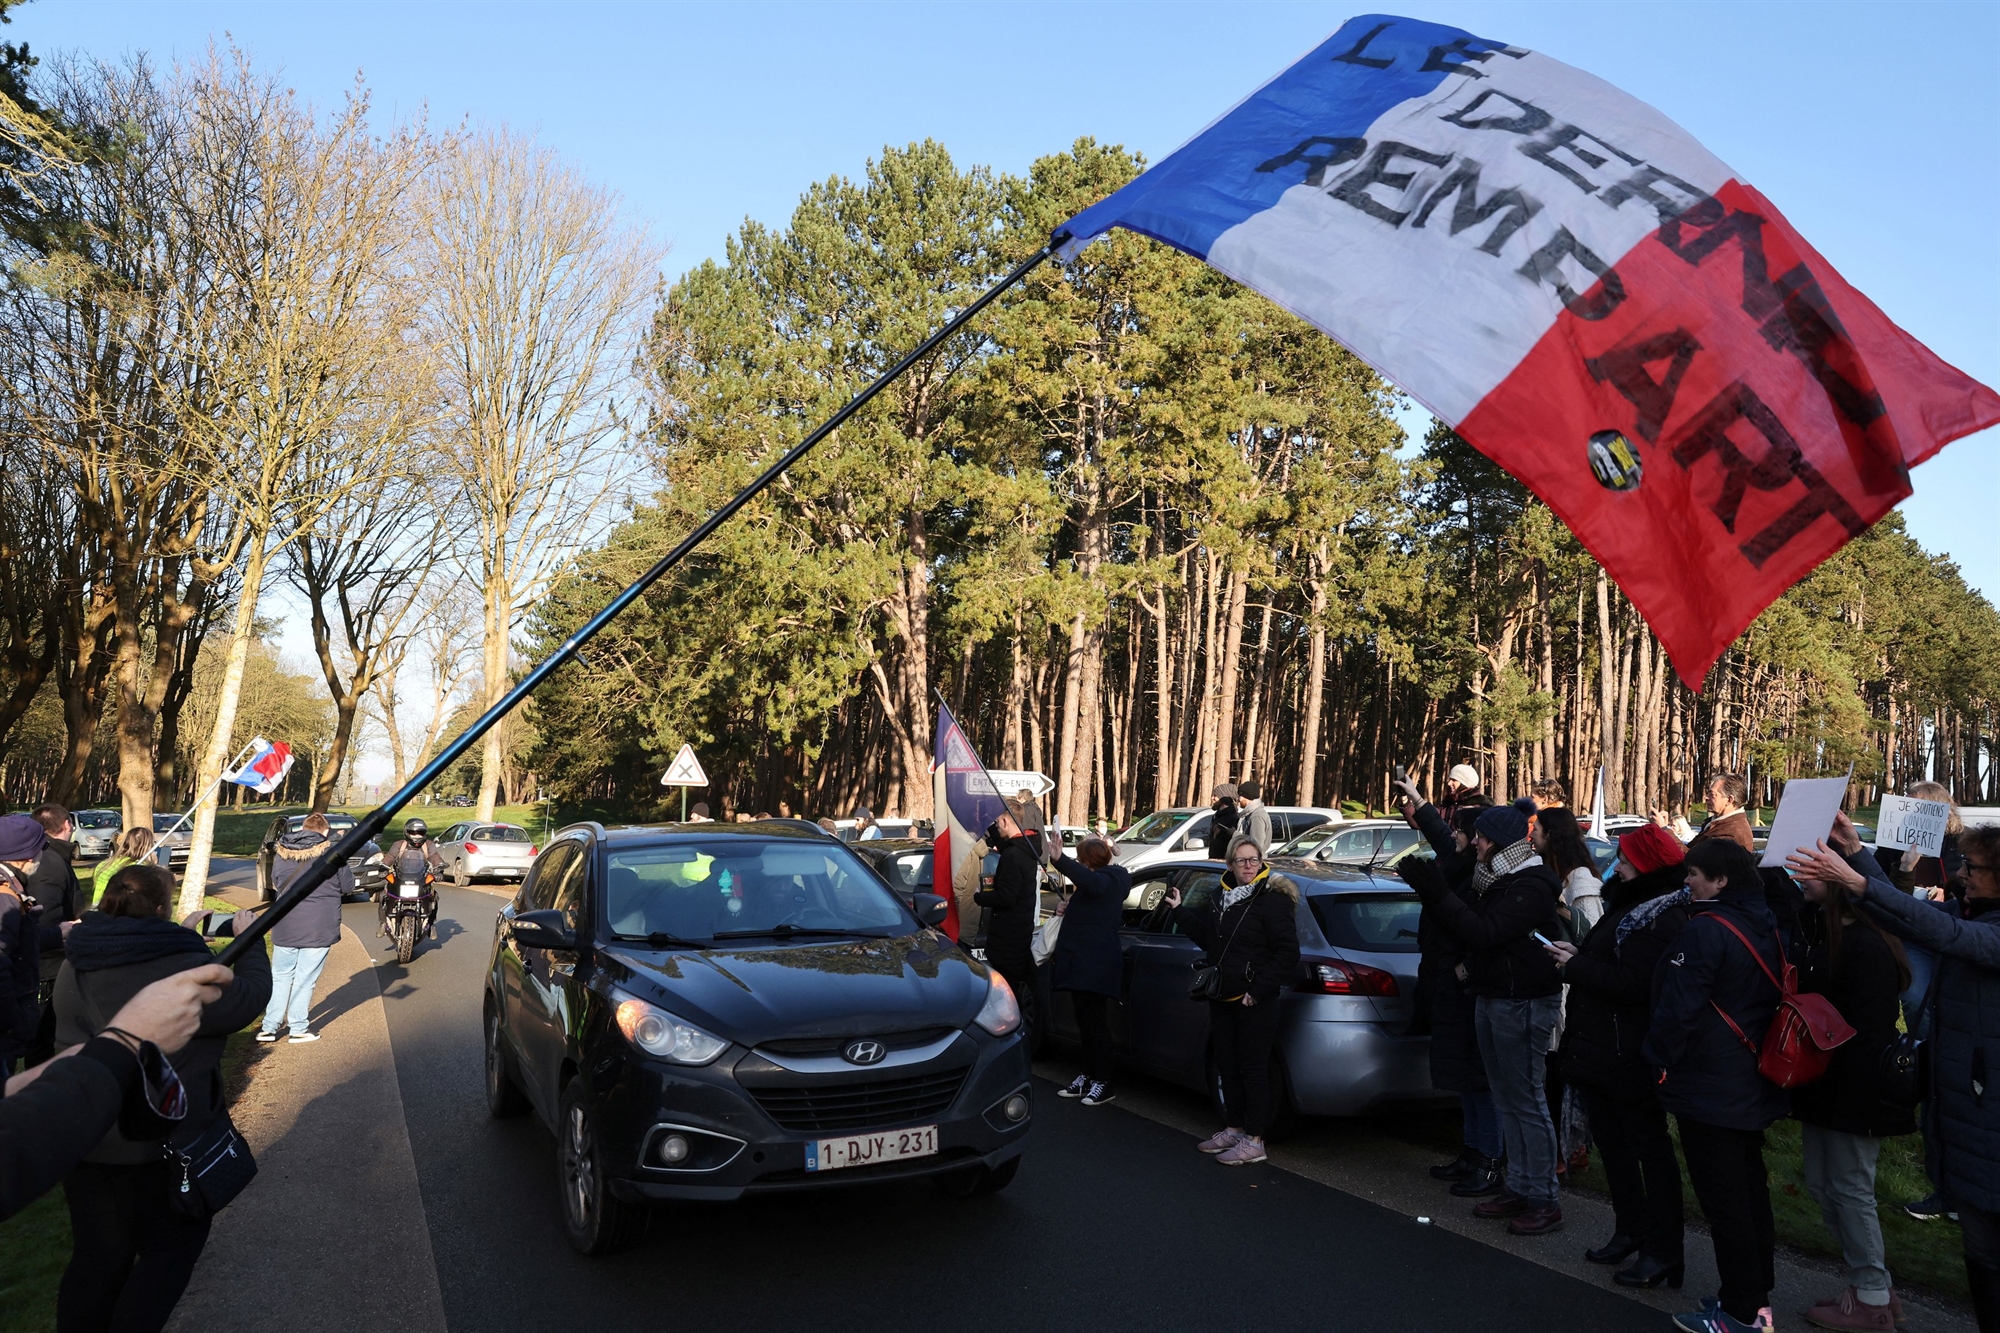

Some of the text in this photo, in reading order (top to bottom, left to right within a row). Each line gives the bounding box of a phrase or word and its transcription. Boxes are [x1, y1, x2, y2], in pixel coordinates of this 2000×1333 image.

[1332, 21, 1531, 80] LE
[1254, 136, 1869, 571] REMPART
[1899, 801, 1944, 817] JE SOUTIENS
[1884, 811, 1942, 832] LE CONVOI DE
[1882, 828, 1893, 840] LA
[807, 1158, 816, 1168] B
